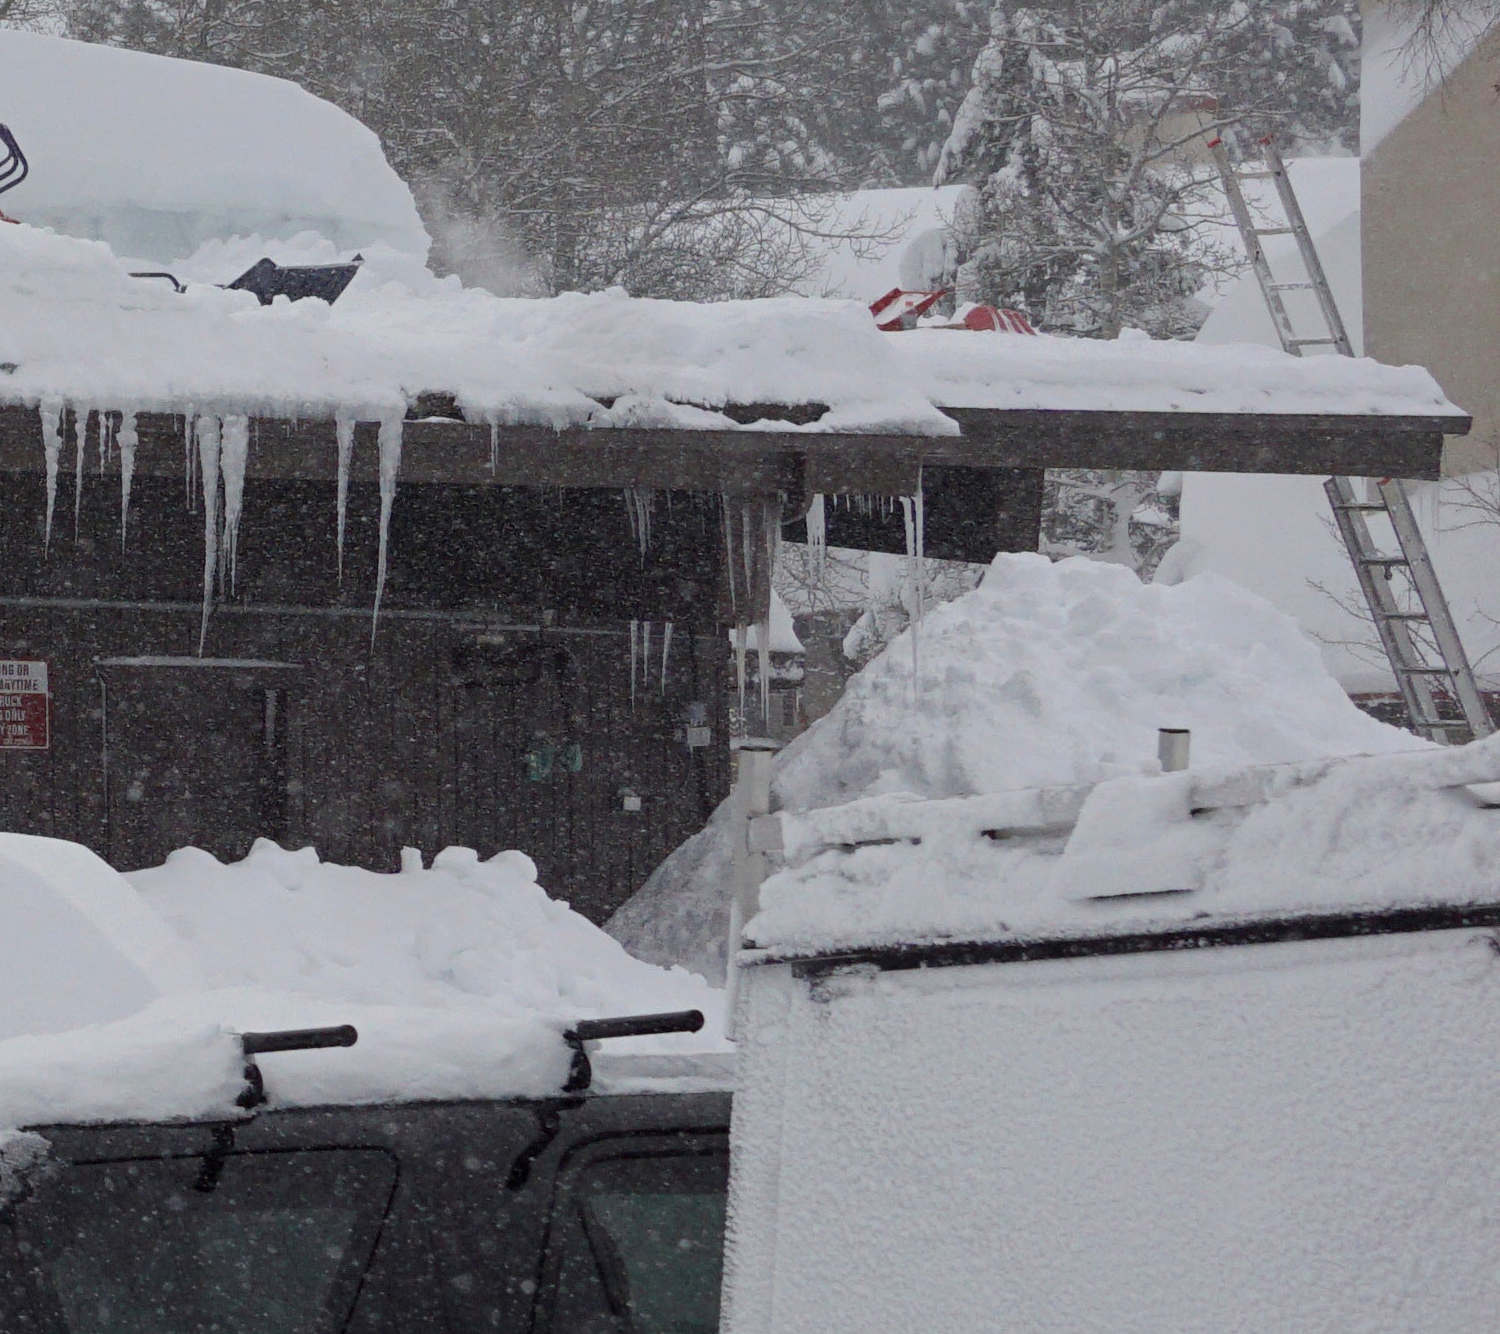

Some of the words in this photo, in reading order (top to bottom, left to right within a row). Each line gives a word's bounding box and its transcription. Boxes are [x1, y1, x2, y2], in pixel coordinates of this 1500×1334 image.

[17, 663, 29, 676] OR
[5, 709, 27, 722] ONLY
[7, 724, 30, 736] ZONE
